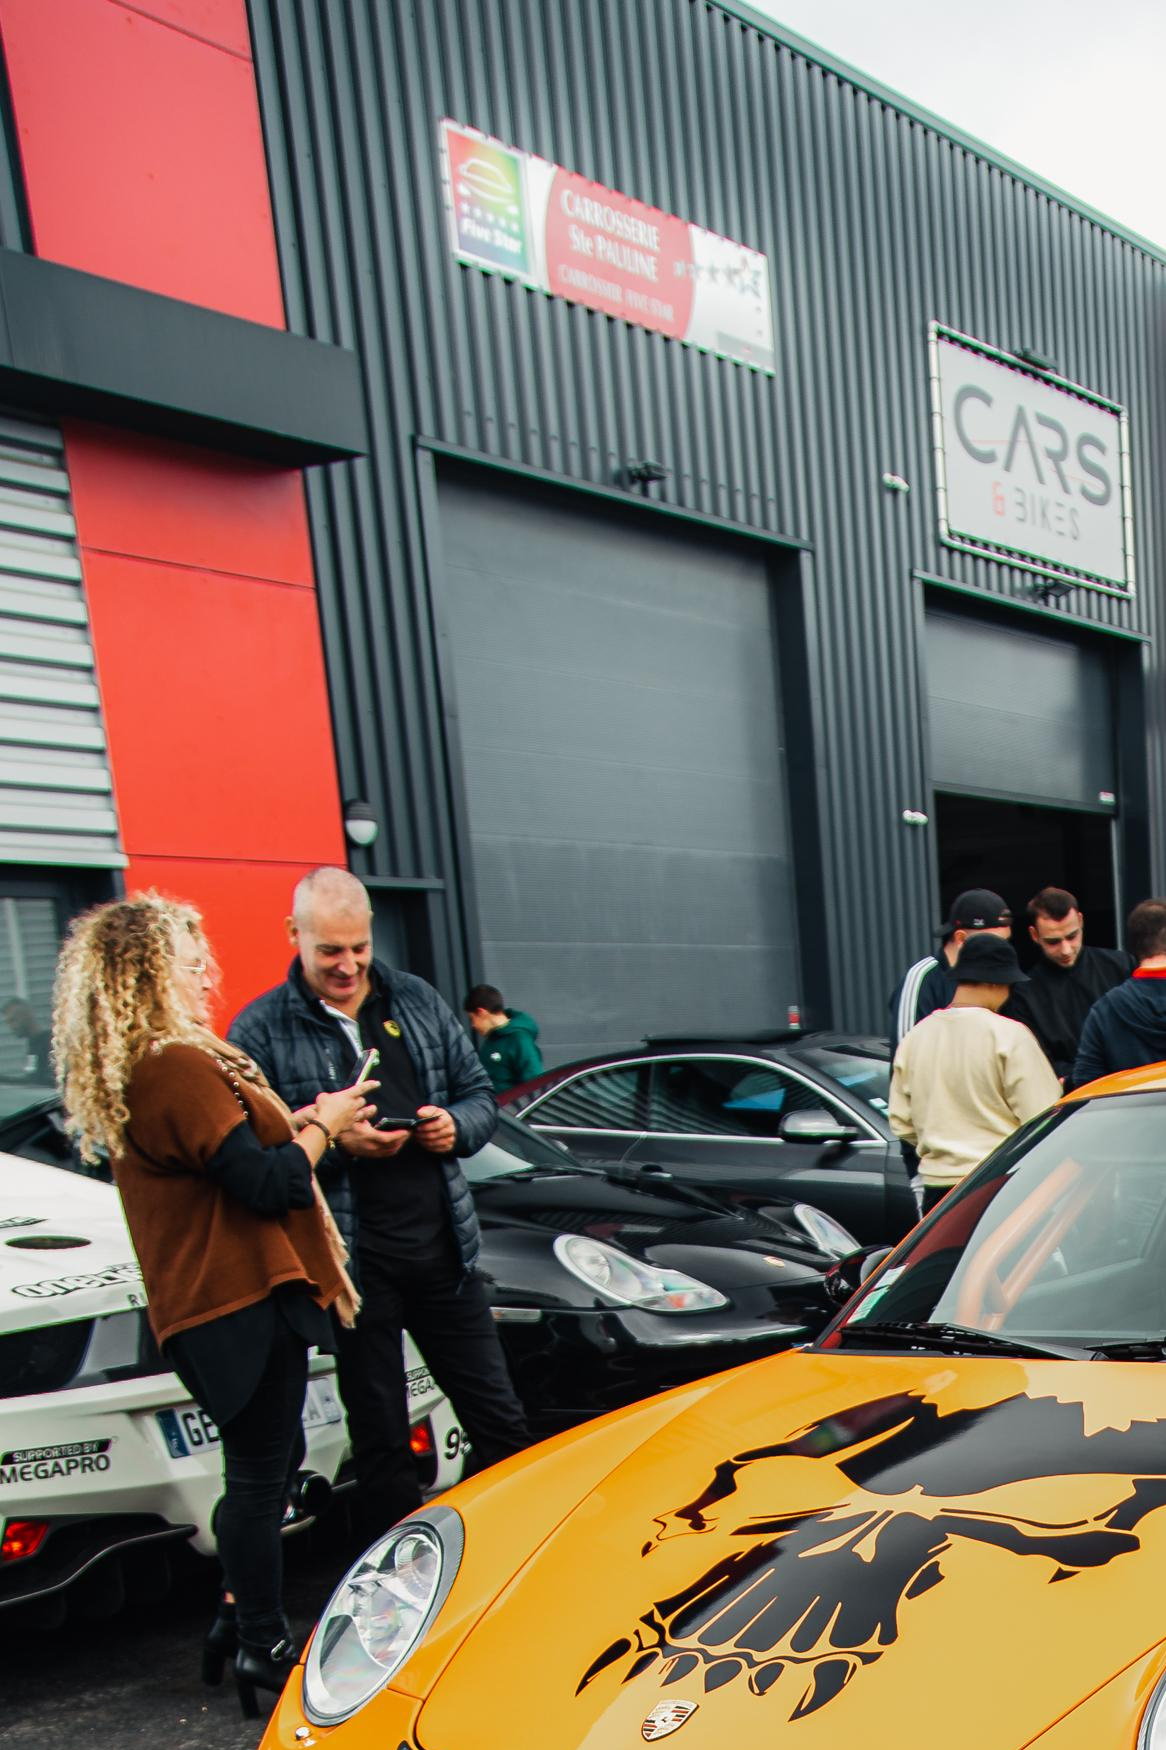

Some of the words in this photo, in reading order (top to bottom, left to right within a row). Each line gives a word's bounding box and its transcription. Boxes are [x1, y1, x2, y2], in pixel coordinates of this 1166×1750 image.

[461, 217, 490, 242] Five
[560, 189, 660, 252] CARROSSERIE
[594, 234, 658, 284] PAULINE
[953, 384, 1112, 506] CARS
[1014, 486, 1081, 541] BIKES
[0, 1453, 111, 1485] MEGAPRO
[12, 1444, 82, 1463] SUPPORTED
[82, 1440, 100, 1455] BY
